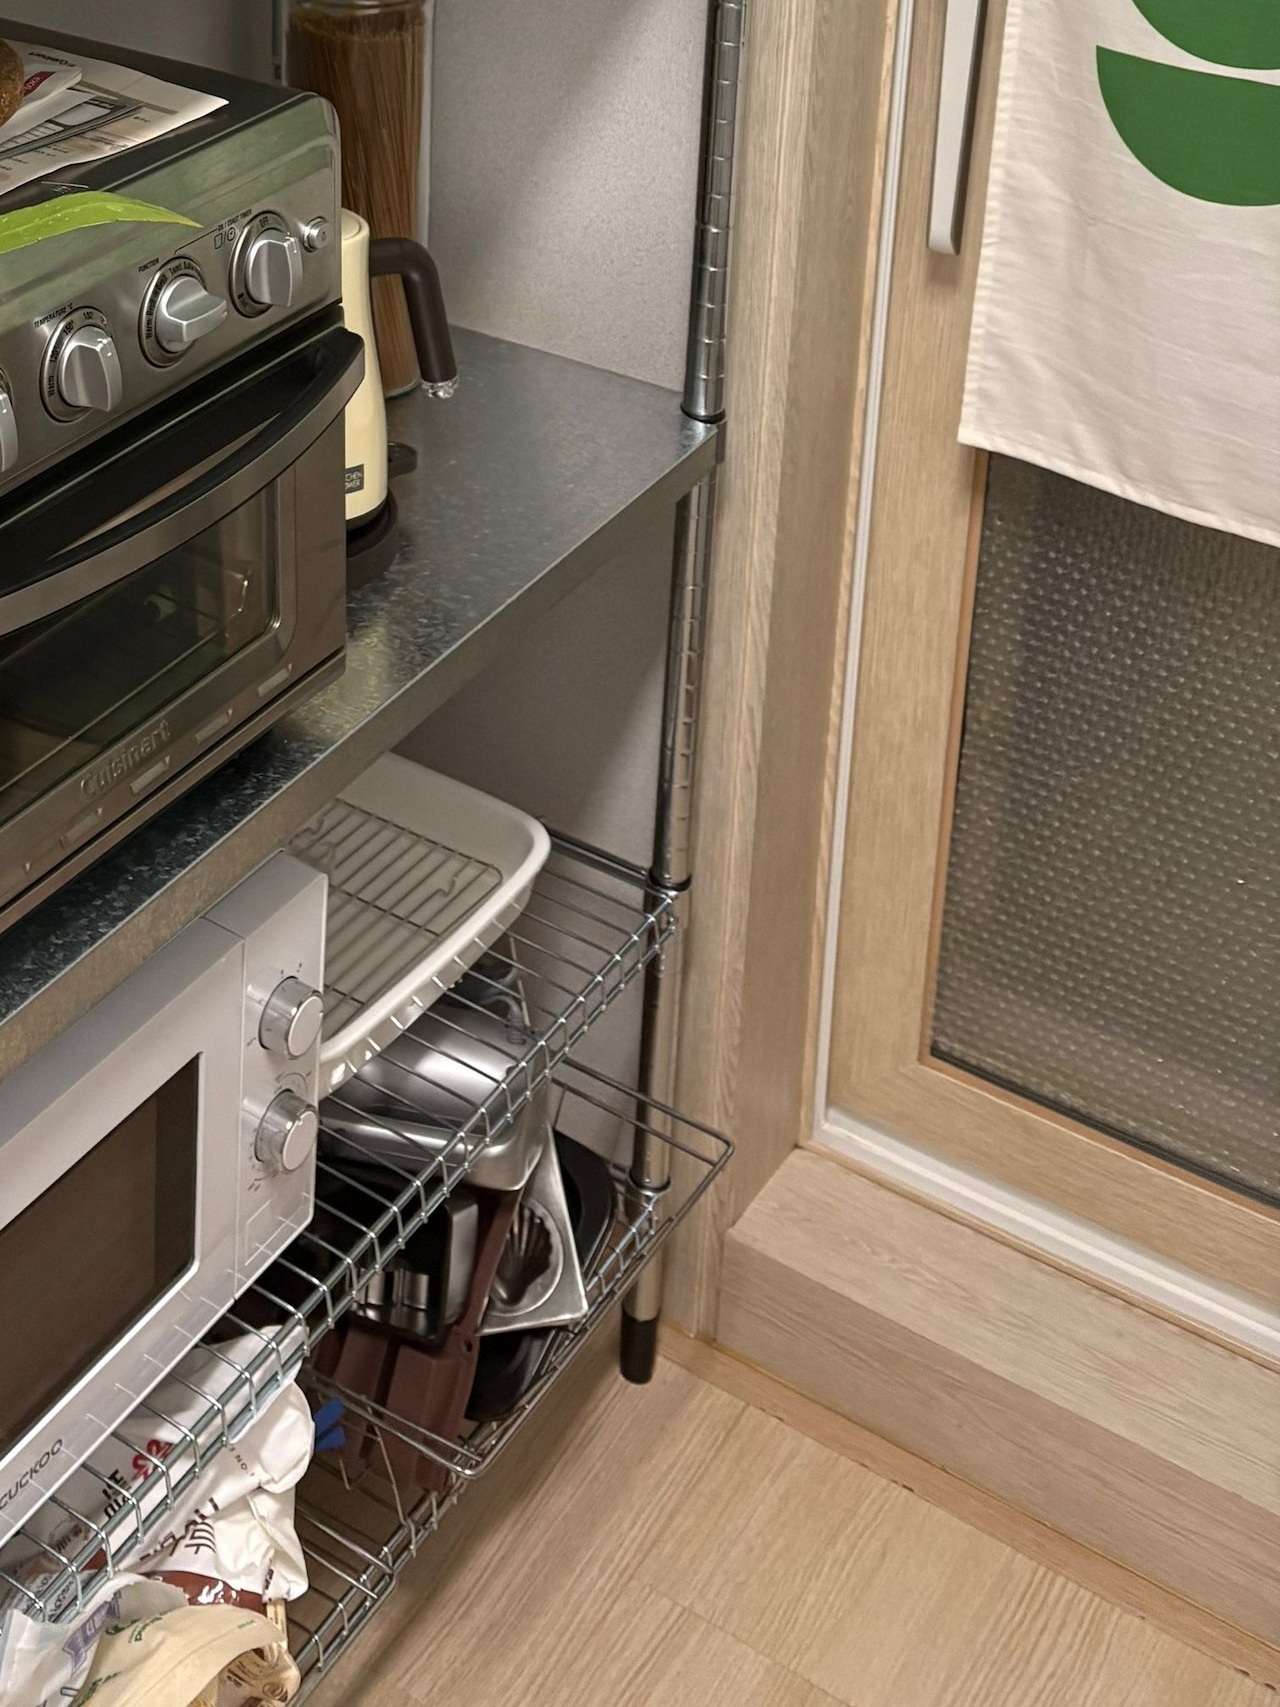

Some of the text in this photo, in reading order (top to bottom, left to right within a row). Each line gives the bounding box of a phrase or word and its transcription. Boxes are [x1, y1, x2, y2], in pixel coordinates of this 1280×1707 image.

[138, 257, 160, 273] FUNCTION
[33, 307, 67, 329] TEMPERATURE
[79, 718, 171, 797] Cuisinart
